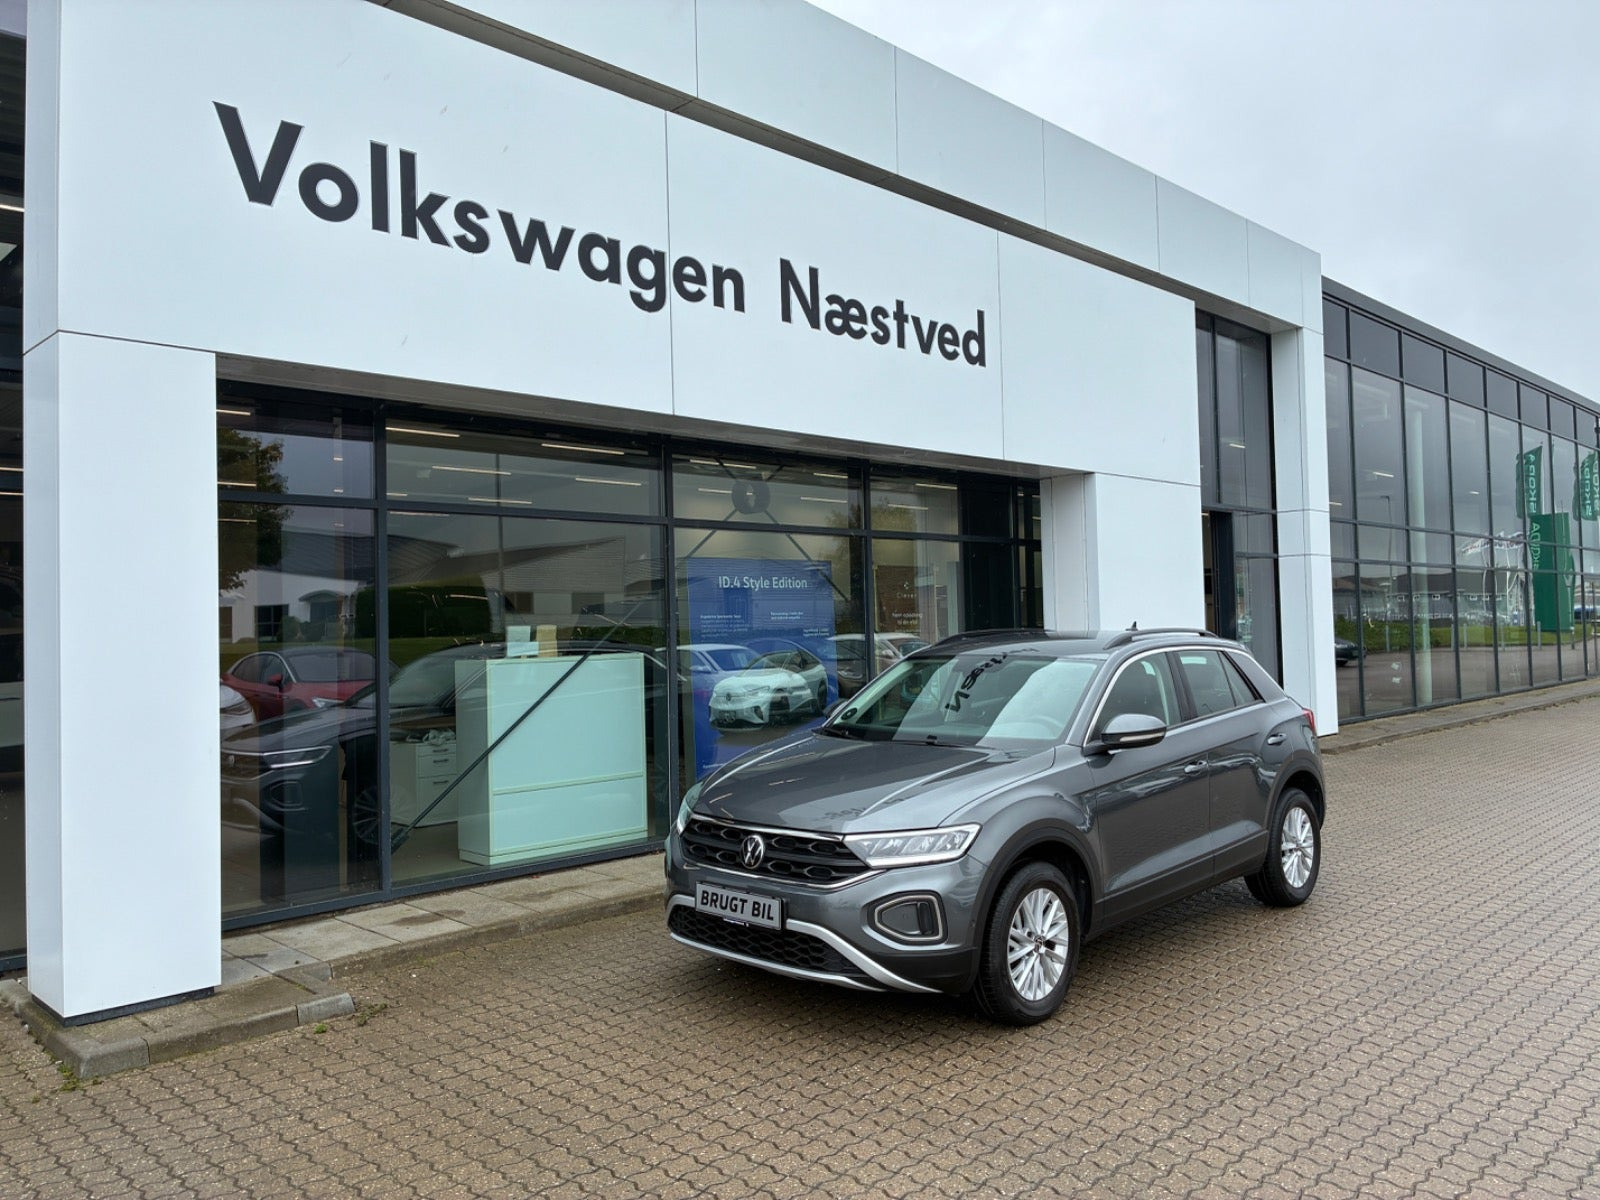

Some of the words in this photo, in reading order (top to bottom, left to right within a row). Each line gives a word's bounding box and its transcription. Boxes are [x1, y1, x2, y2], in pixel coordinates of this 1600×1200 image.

[213, 100, 746, 313] Volkswagen
[779, 257, 987, 368] Næstved
[718, 576, 741, 589] ID.4
[743, 576, 770, 592] Style
[772, 577, 808, 589] Edition
[700, 890, 748, 914] BRUGT
[751, 901, 774, 921] BIL
